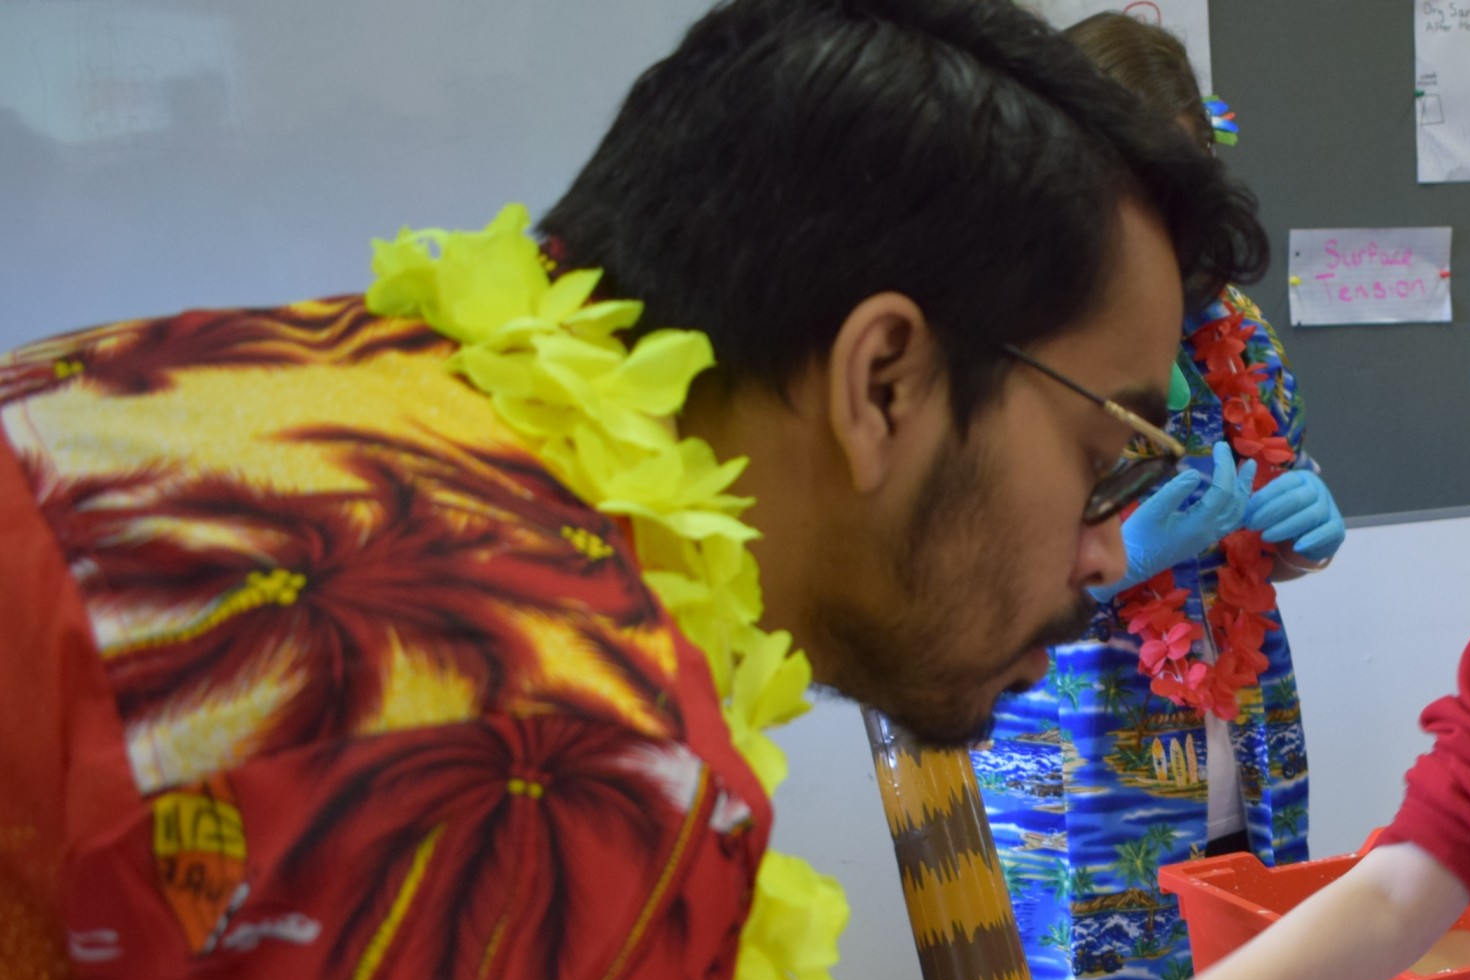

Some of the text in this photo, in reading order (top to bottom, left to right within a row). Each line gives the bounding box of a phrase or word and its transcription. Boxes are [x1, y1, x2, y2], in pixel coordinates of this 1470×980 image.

[1423, 1, 1445, 23] Dry
[1323, 239, 1414, 270] Surface
[1315, 271, 1426, 304] Tension
